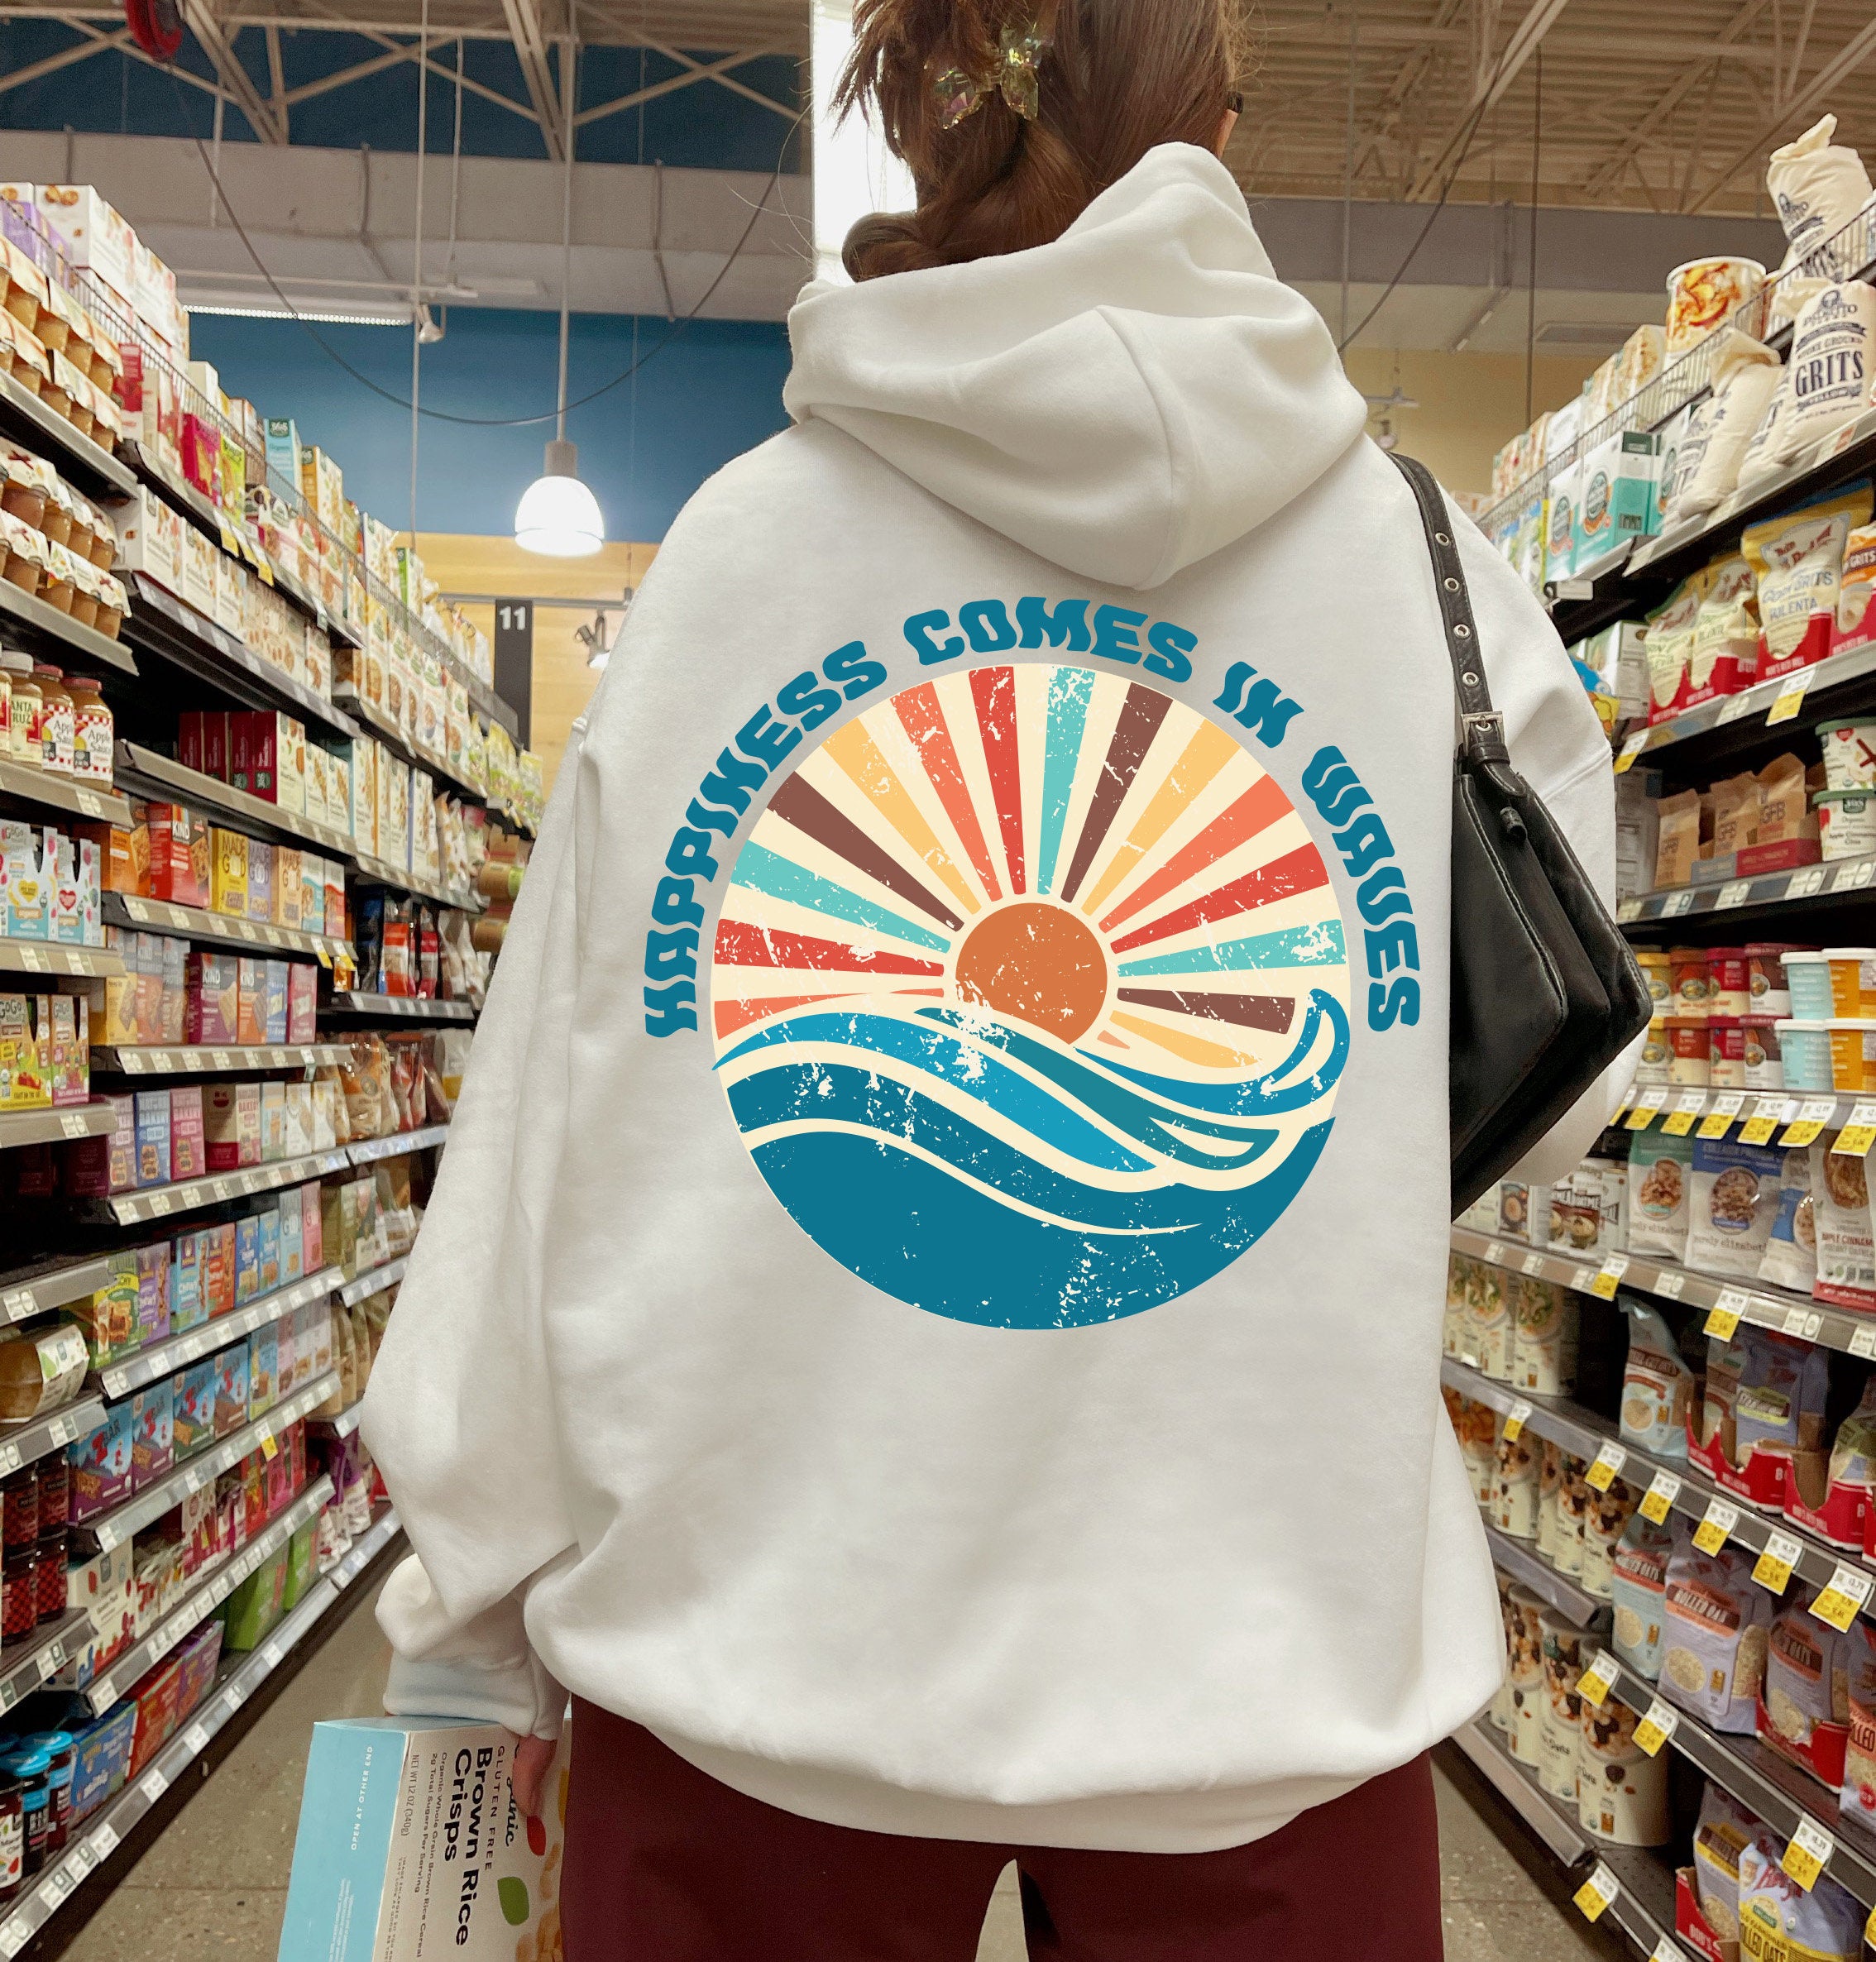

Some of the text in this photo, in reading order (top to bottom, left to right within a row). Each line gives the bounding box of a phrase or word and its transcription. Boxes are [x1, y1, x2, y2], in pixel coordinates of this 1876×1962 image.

[1796, 351, 1863, 397] GRITS
[499, 605, 526, 631] 11
[12, 701, 32, 712] ANTA
[12, 712, 32, 725] RUZ
[172, 821, 190, 840] KIND
[644, 596, 1420, 1038] HAPPINESS COMES IN WAVES
[1760, 801, 1786, 824] GFB
[202, 968, 221, 986] KIND
[1673, 1590, 1728, 1625] ROLLED OA
[1853, 1722, 1876, 1752] LLED
[351, 1746, 374, 1850] OPEN AT OTHER END
[400, 1754, 420, 1837] NET WT 12 OZ (340g)
[443, 1748, 472, 1862] Crisps
[485, 1745, 505, 1871] GLUTEN FREE
[414, 1752, 438, 1893] 2g Total Sugars Per Serving
[416, 1752, 447, 1958] Organic Whole Grain Brown Rice Cereal
[456, 1747, 494, 1946] Brown Rice
